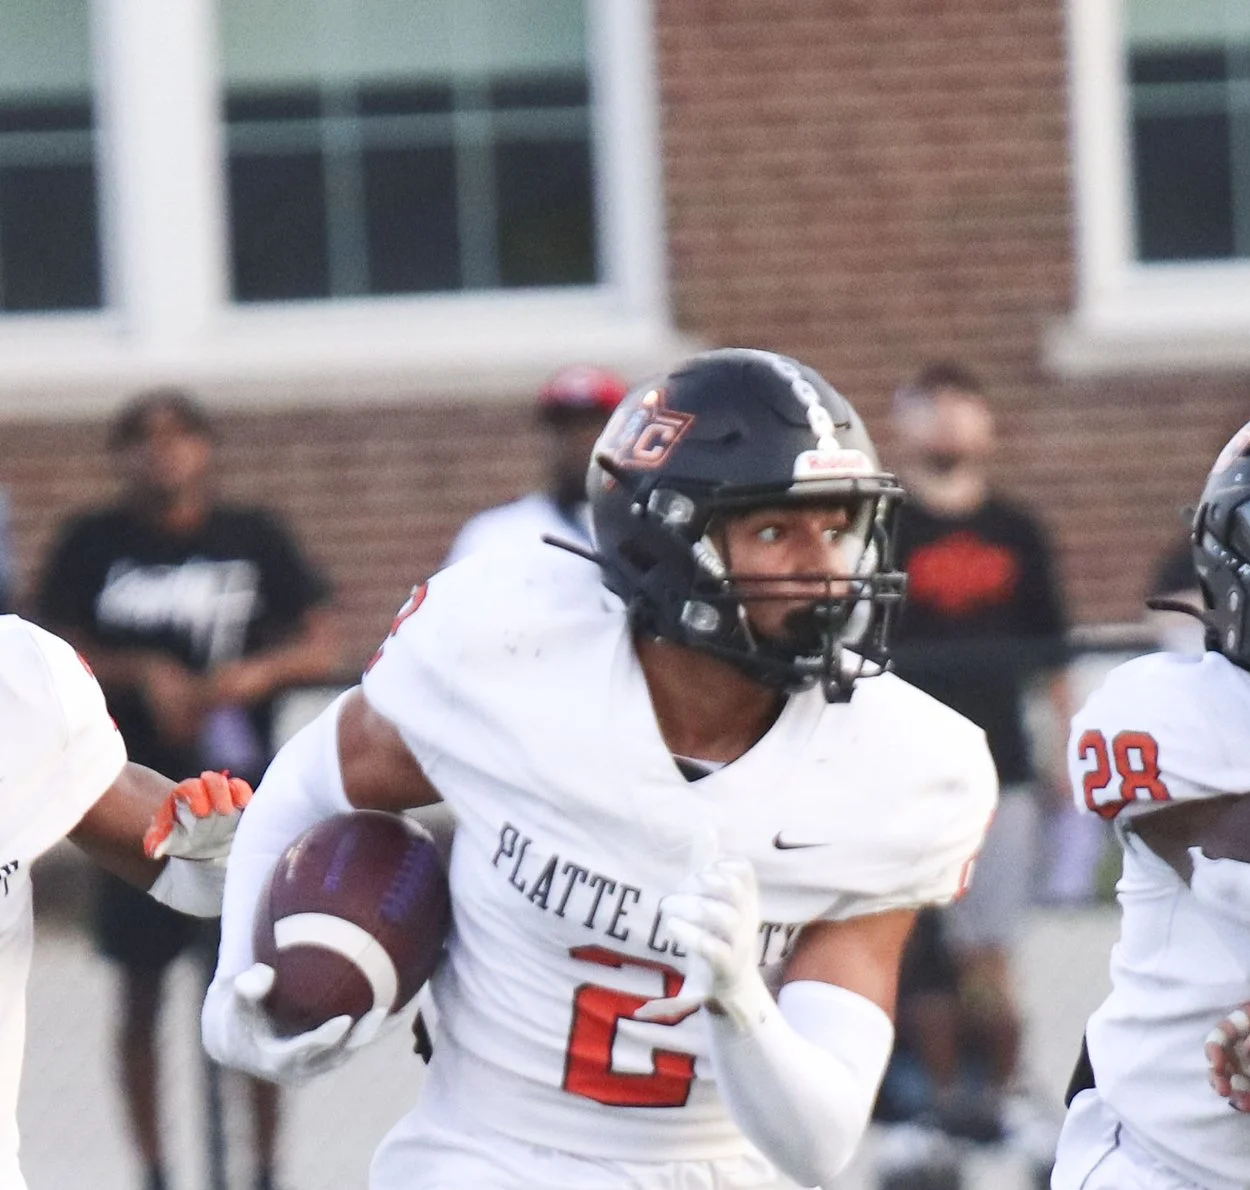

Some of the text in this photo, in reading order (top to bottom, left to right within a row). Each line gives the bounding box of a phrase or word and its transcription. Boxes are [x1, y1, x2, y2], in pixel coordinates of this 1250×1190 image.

[1078, 729, 1172, 821] 28
[492, 822, 641, 942] PLATTE
[563, 944, 701, 1107] 2
